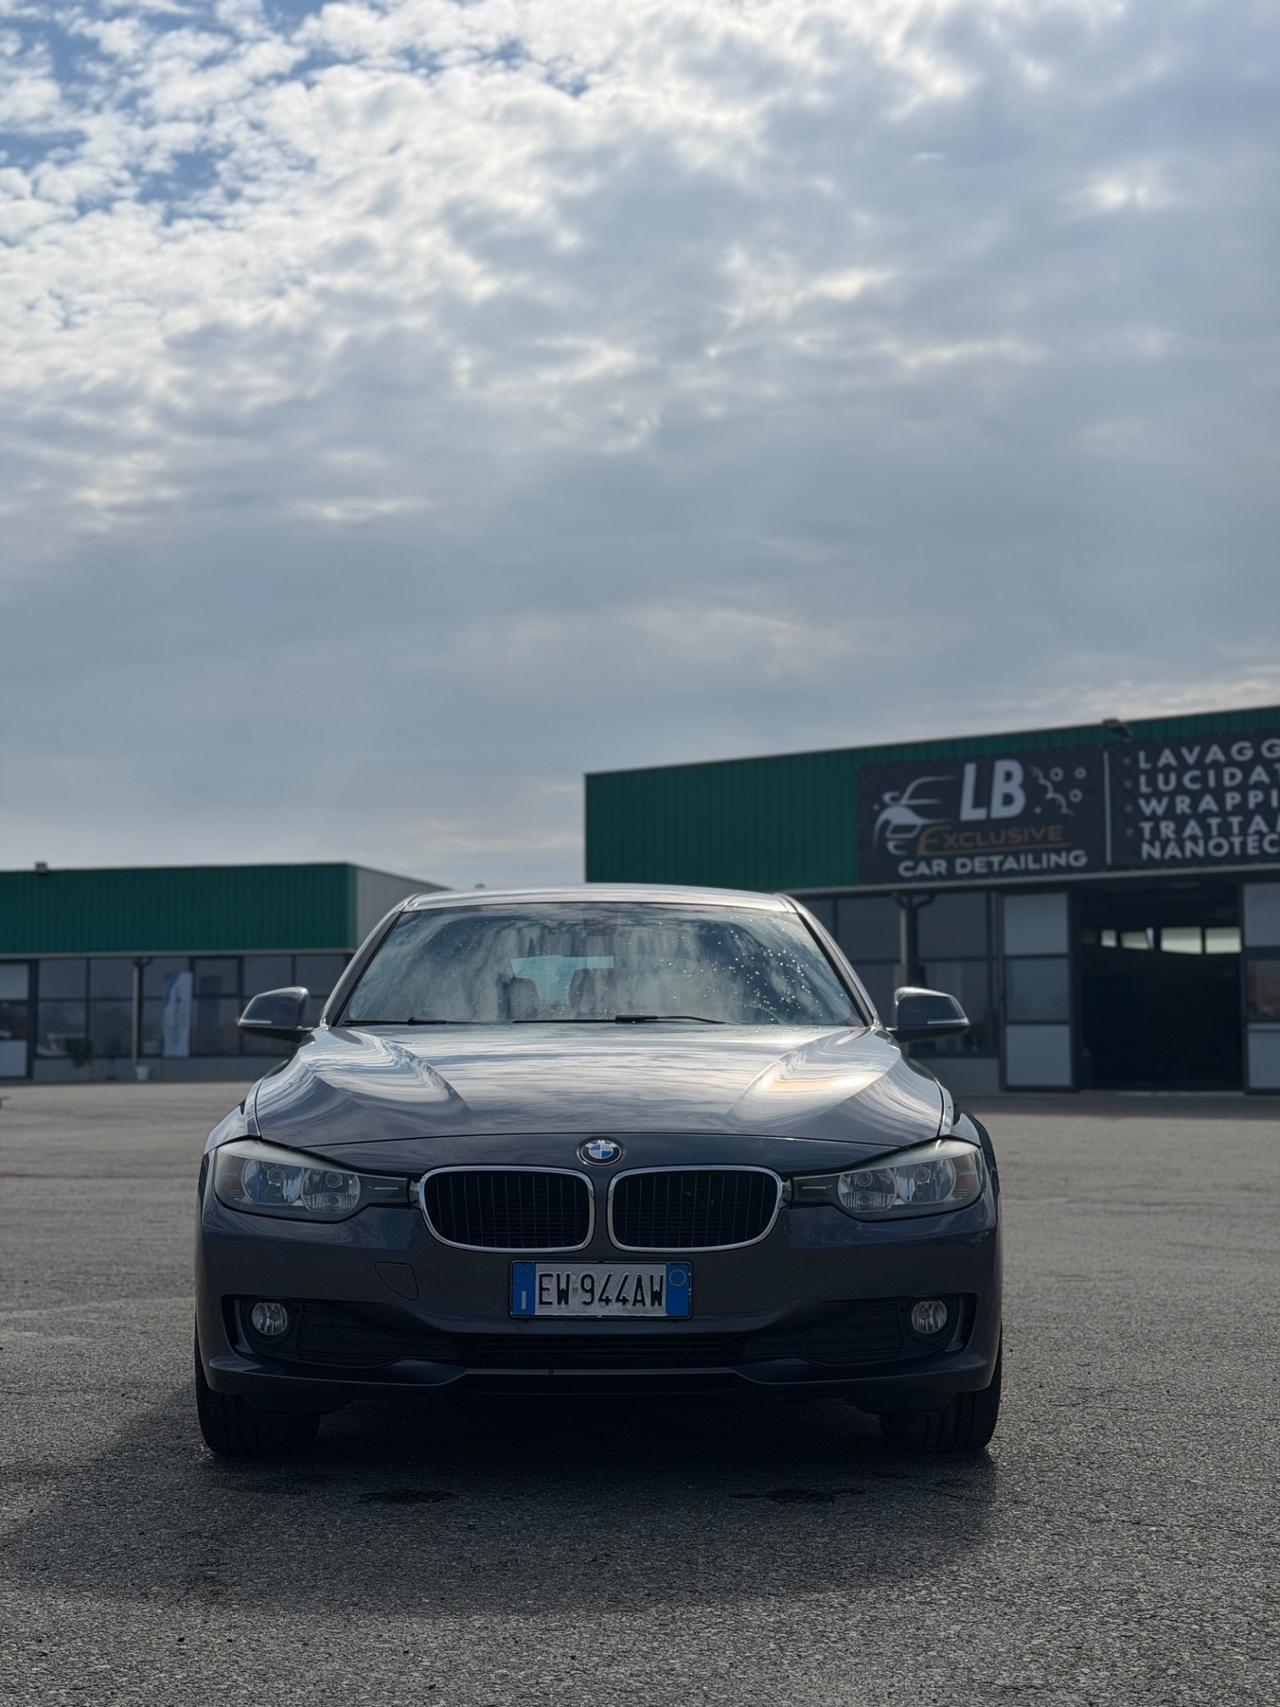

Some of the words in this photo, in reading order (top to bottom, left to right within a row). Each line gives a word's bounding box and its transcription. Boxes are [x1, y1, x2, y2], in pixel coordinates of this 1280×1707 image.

[959, 758, 1026, 822] LB
[917, 824, 1065, 856] EXCLUSIVE
[1139, 812, 1280, 842] TRATTA
[899, 858, 948, 878] CAR
[954, 849, 1088, 875] DETAILING
[538, 1273, 571, 1306] EW
